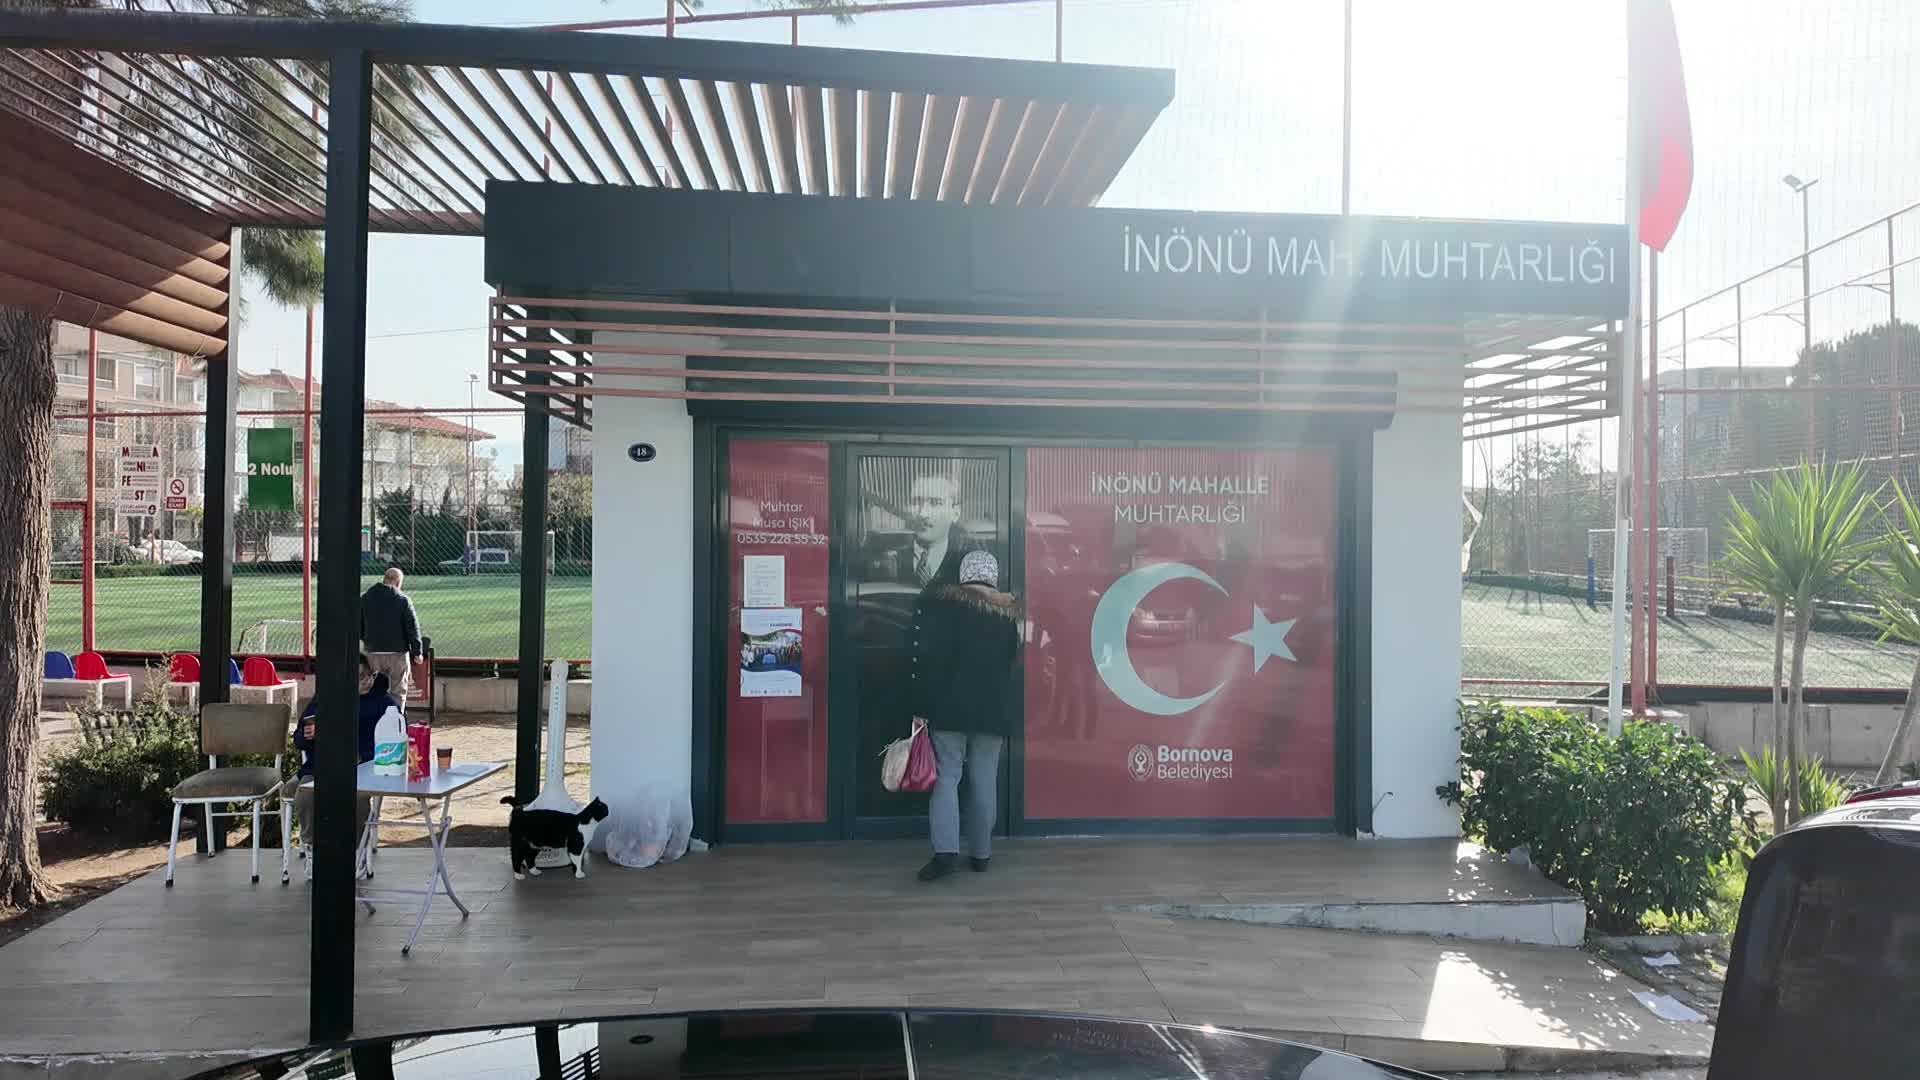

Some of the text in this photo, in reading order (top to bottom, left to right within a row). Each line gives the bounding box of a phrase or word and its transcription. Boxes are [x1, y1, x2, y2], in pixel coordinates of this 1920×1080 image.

[1123, 224, 1253, 275] İNÖNÜ
[1380, 238, 1616, 284] MUHTARLIĞI
[637, 447, 647, 457] 18
[248, 462, 293, 476] 2 Nolu
[1091, 471, 1269, 495] İNÖNÜ MAHALLE
[760, 500, 803, 512] Muhtar
[1114, 501, 1246, 524] MUHTARLIĞI
[752, 517, 785, 528] Musa
[1157, 745, 1233, 762] Bornova
[1157, 763, 1233, 782] Belediyesi
